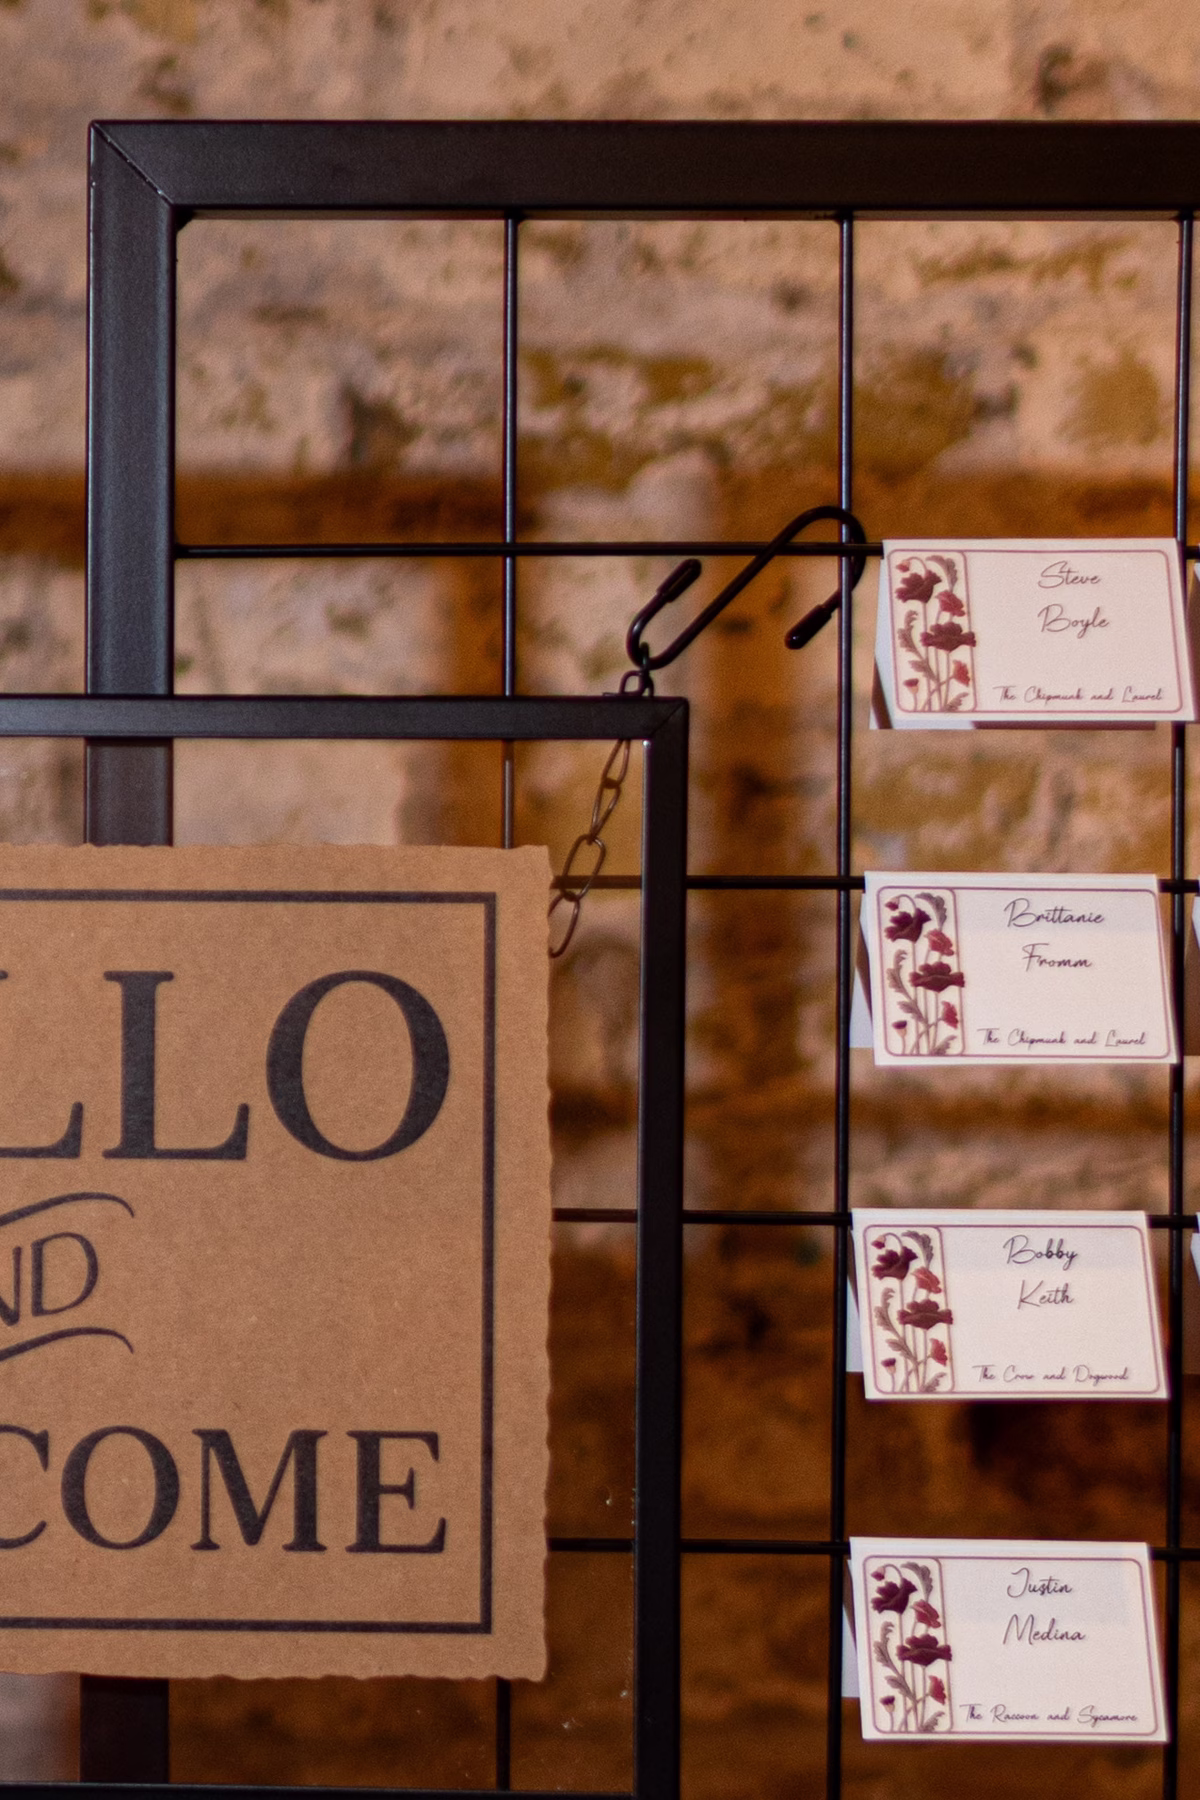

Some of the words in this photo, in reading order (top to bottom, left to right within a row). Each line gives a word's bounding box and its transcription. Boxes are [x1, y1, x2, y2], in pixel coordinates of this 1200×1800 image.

[1037, 560, 1102, 590] Steve
[1037, 603, 1110, 640] Boyle
[1003, 897, 1105, 928] Brittanie
[1022, 942, 1093, 971] Fromm
[1002, 1234, 1079, 1271] Bobby
[1017, 1280, 1074, 1310] Keith
[1006, 1567, 1073, 1599] Justin
[1002, 1613, 1086, 1646] Medina
[960, 1703, 983, 1721] The
[990, 1703, 1040, 1723] Raccoon
[1046, 1706, 1071, 1722] and
[1077, 1704, 1138, 1729] Sycamore
